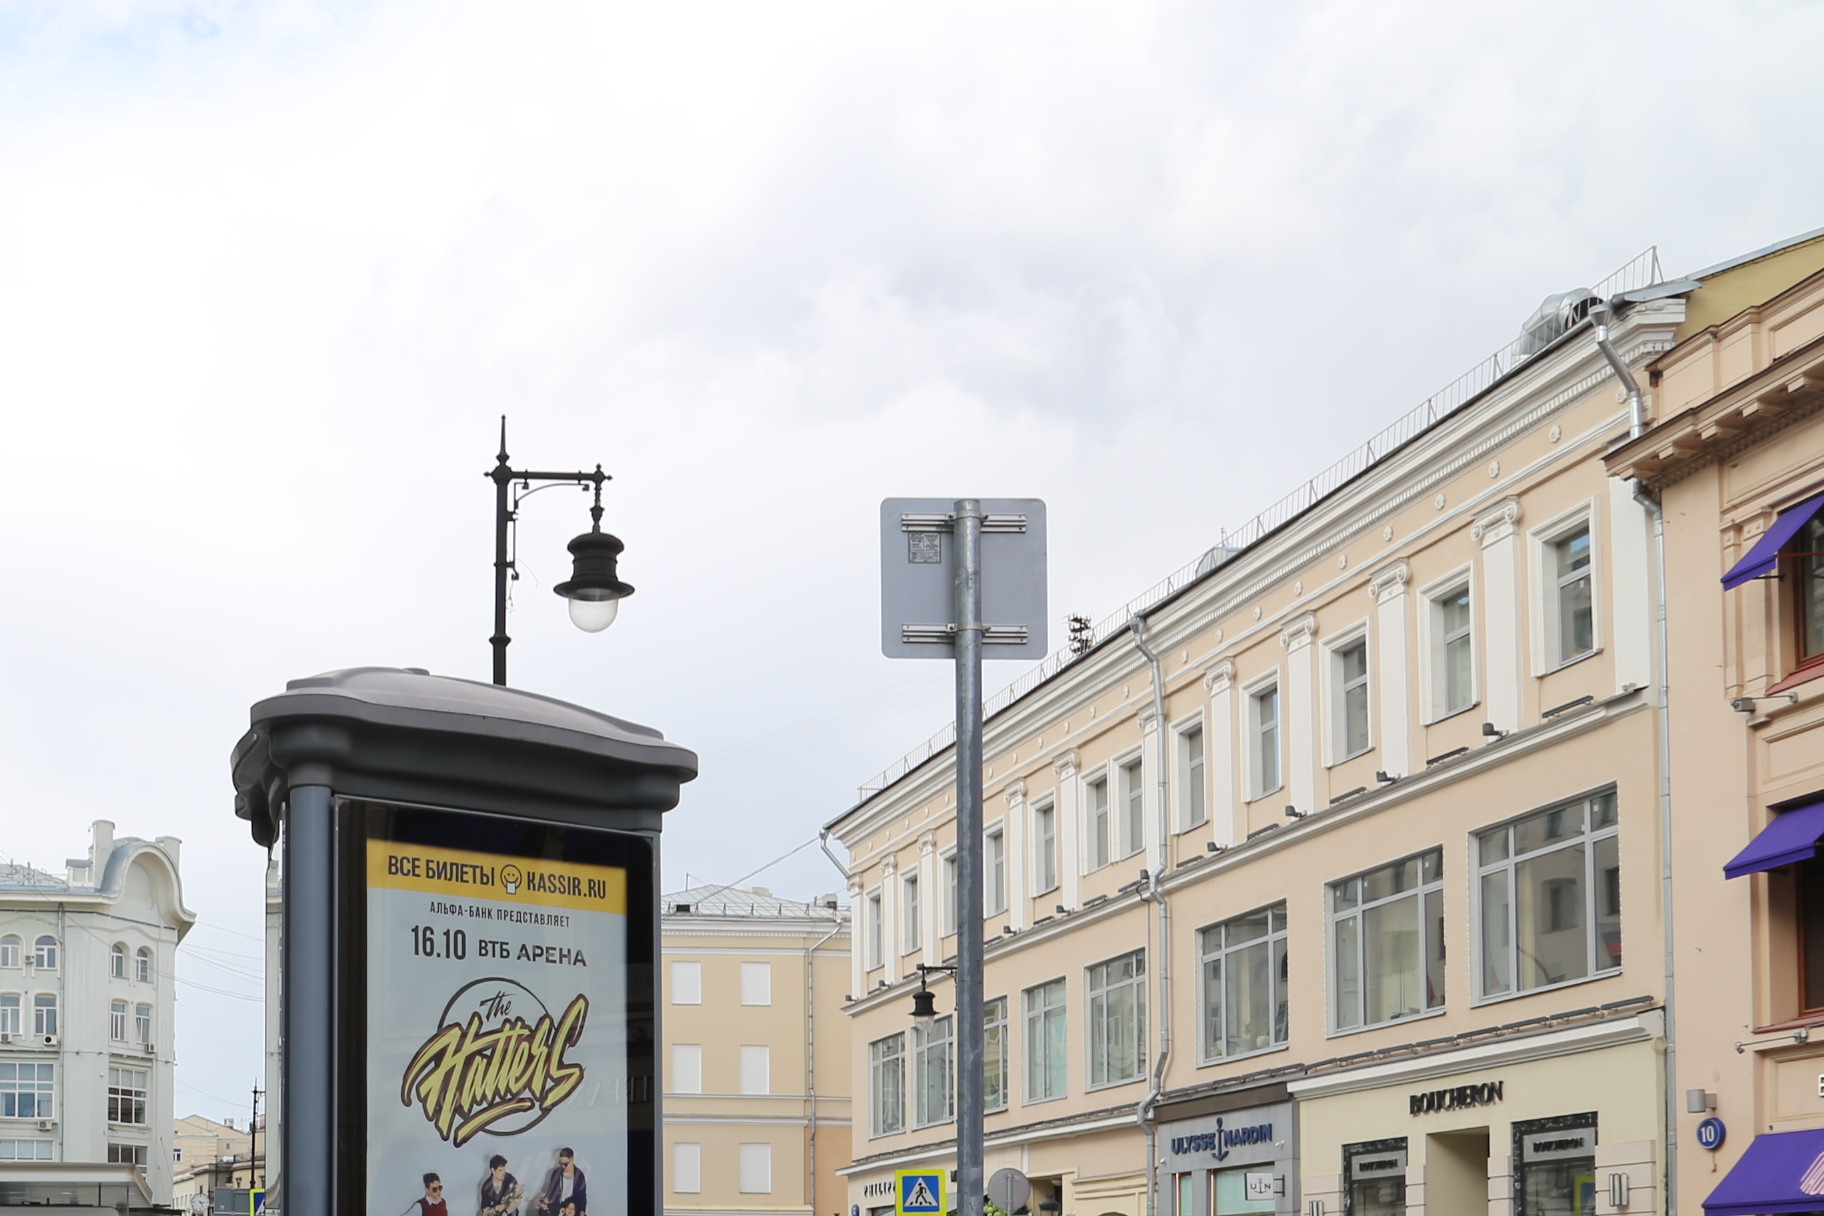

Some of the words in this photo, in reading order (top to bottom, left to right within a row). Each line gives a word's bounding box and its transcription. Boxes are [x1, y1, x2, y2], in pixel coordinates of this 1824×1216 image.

[388, 855, 421, 878] ВСЕ
[426, 859, 494, 886] БИЛЕТЫ
[527, 871, 607, 899] KASSIR.RU
[430, 901, 493, 920] АЛЬФА-БАНК
[497, 908, 570, 928] ПРЕДСТАВЛЯЕТ
[411, 925, 467, 960] 16.10
[478, 940, 510, 959] ВТБ
[517, 944, 587, 967] АРЕНА
[480, 990, 516, 1022] the
[1409, 1081, 1504, 1115] BOUCHERON
[1171, 1132, 1216, 1155] ULYSSE
[1223, 1123, 1273, 1148] NARDIN
[1700, 1125, 1714, 1143] 10
[864, 1181, 896, 1198] PHILIP
